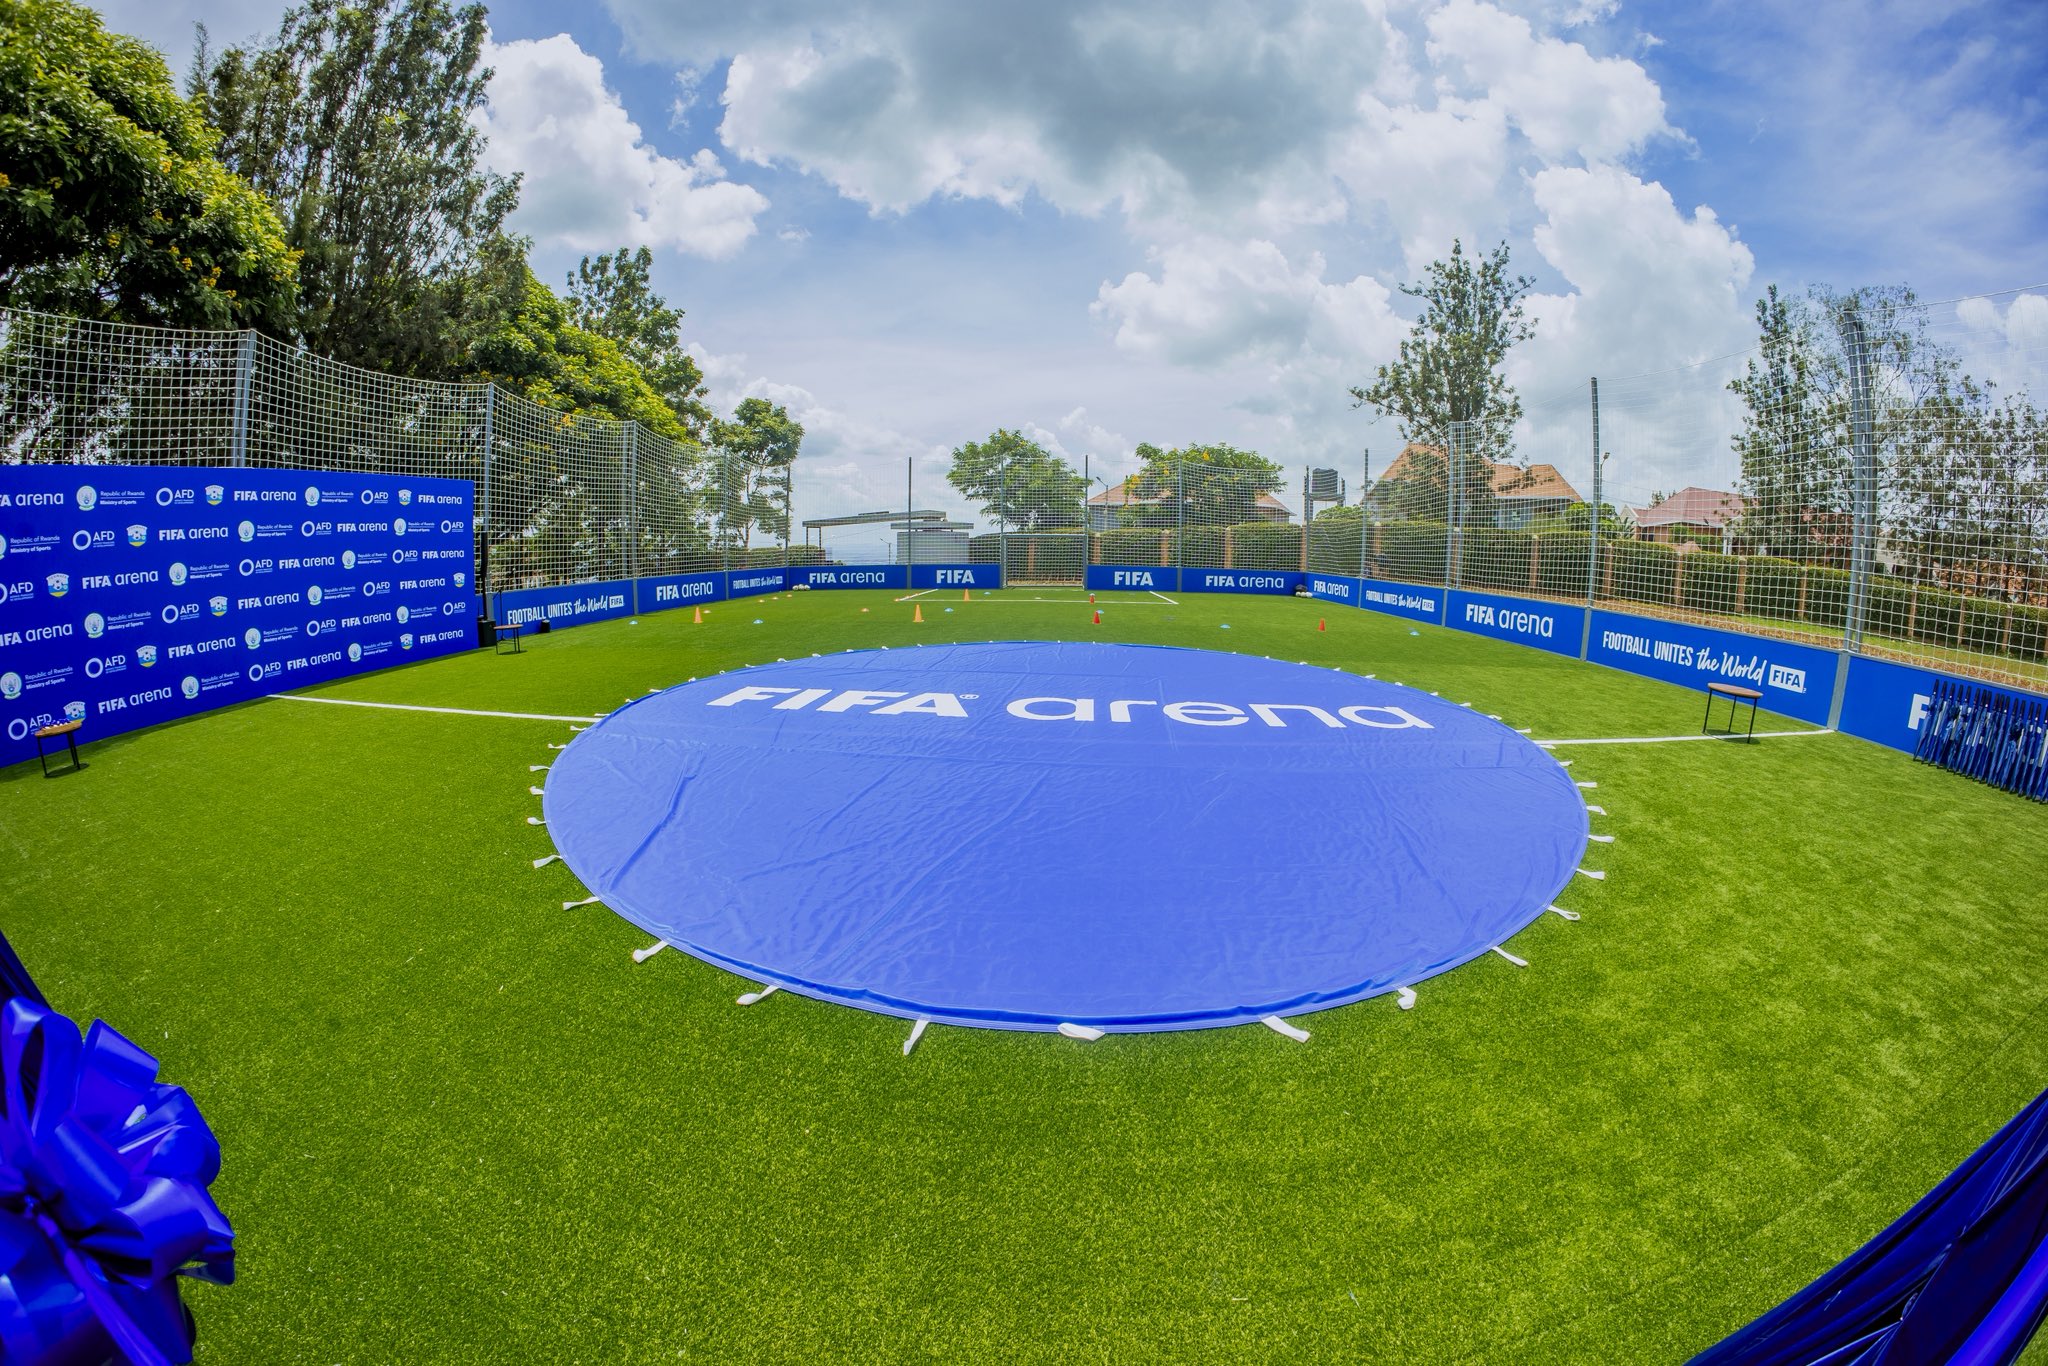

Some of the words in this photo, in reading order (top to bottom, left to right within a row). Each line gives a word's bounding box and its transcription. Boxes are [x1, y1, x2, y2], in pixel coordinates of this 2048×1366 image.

[0, 495, 11, 506] A
[16, 493, 63, 506] arena
[175, 490, 194, 498] AFD
[234, 491, 258, 500] FIFA
[261, 491, 296, 500] arena
[418, 495, 435, 503] FIFA
[437, 496, 462, 504] arena
[159, 529, 185, 540] FIFA
[189, 527, 228, 539] arena
[337, 524, 356, 532] FIFA
[359, 523, 387, 531] arena
[93, 531, 114, 542] AFD
[255, 559, 272, 569] AFD
[279, 559, 300, 569] FIFA
[303, 557, 334, 567] arena
[82, 576, 111, 589] FIFA
[115, 571, 158, 585] arena
[810, 573, 836, 583] FIFA
[840, 572, 884, 583] arena
[937, 570, 974, 583] FIFA
[1115, 572, 1153, 585] FIFA
[1206, 576, 1234, 587] FIFA
[1239, 577, 1284, 588] arena
[10, 582, 33, 595] AFD
[400, 580, 417, 589] FIFA
[419, 578, 445, 588] arena
[1313, 580, 1326, 594] FIFA
[1327, 583, 1348, 597] arena
[656, 585, 679, 601] FIFA
[682, 582, 712, 598] arena
[238, 598, 261, 609] FIFA
[264, 593, 299, 606] arena
[180, 604, 199, 615] AFD
[507, 606, 546, 624] FOOTBALL
[548, 602, 572, 618] UNITES
[574, 598, 587, 614] the
[587, 595, 608, 613] World
[321, 619, 336, 629] AFD
[342, 617, 360, 627] FIFA
[363, 613, 391, 624] arena
[1466, 604, 1494, 626] FIFA
[1499, 610, 1553, 637] arena
[26, 624, 72, 641] arena
[420, 634, 437, 643] FIFA
[438, 630, 463, 640] arena
[168, 645, 194, 658] FIFA
[197, 637, 236, 652] arena
[105, 655, 125, 668] AFD
[287, 658, 308, 670] FIFA
[310, 652, 341, 665] arena
[1603, 630, 1650, 657] FOOTBALL
[1654, 640, 1693, 667] UNITES
[1696, 647, 1719, 671] the
[1720, 652, 1767, 686] World
[1772, 669, 1800, 688] FIFA
[265, 662, 281, 672] AFD
[98, 698, 127, 713] FIFA
[130, 687, 171, 705] arena
[1007, 696, 1434, 729] arena
